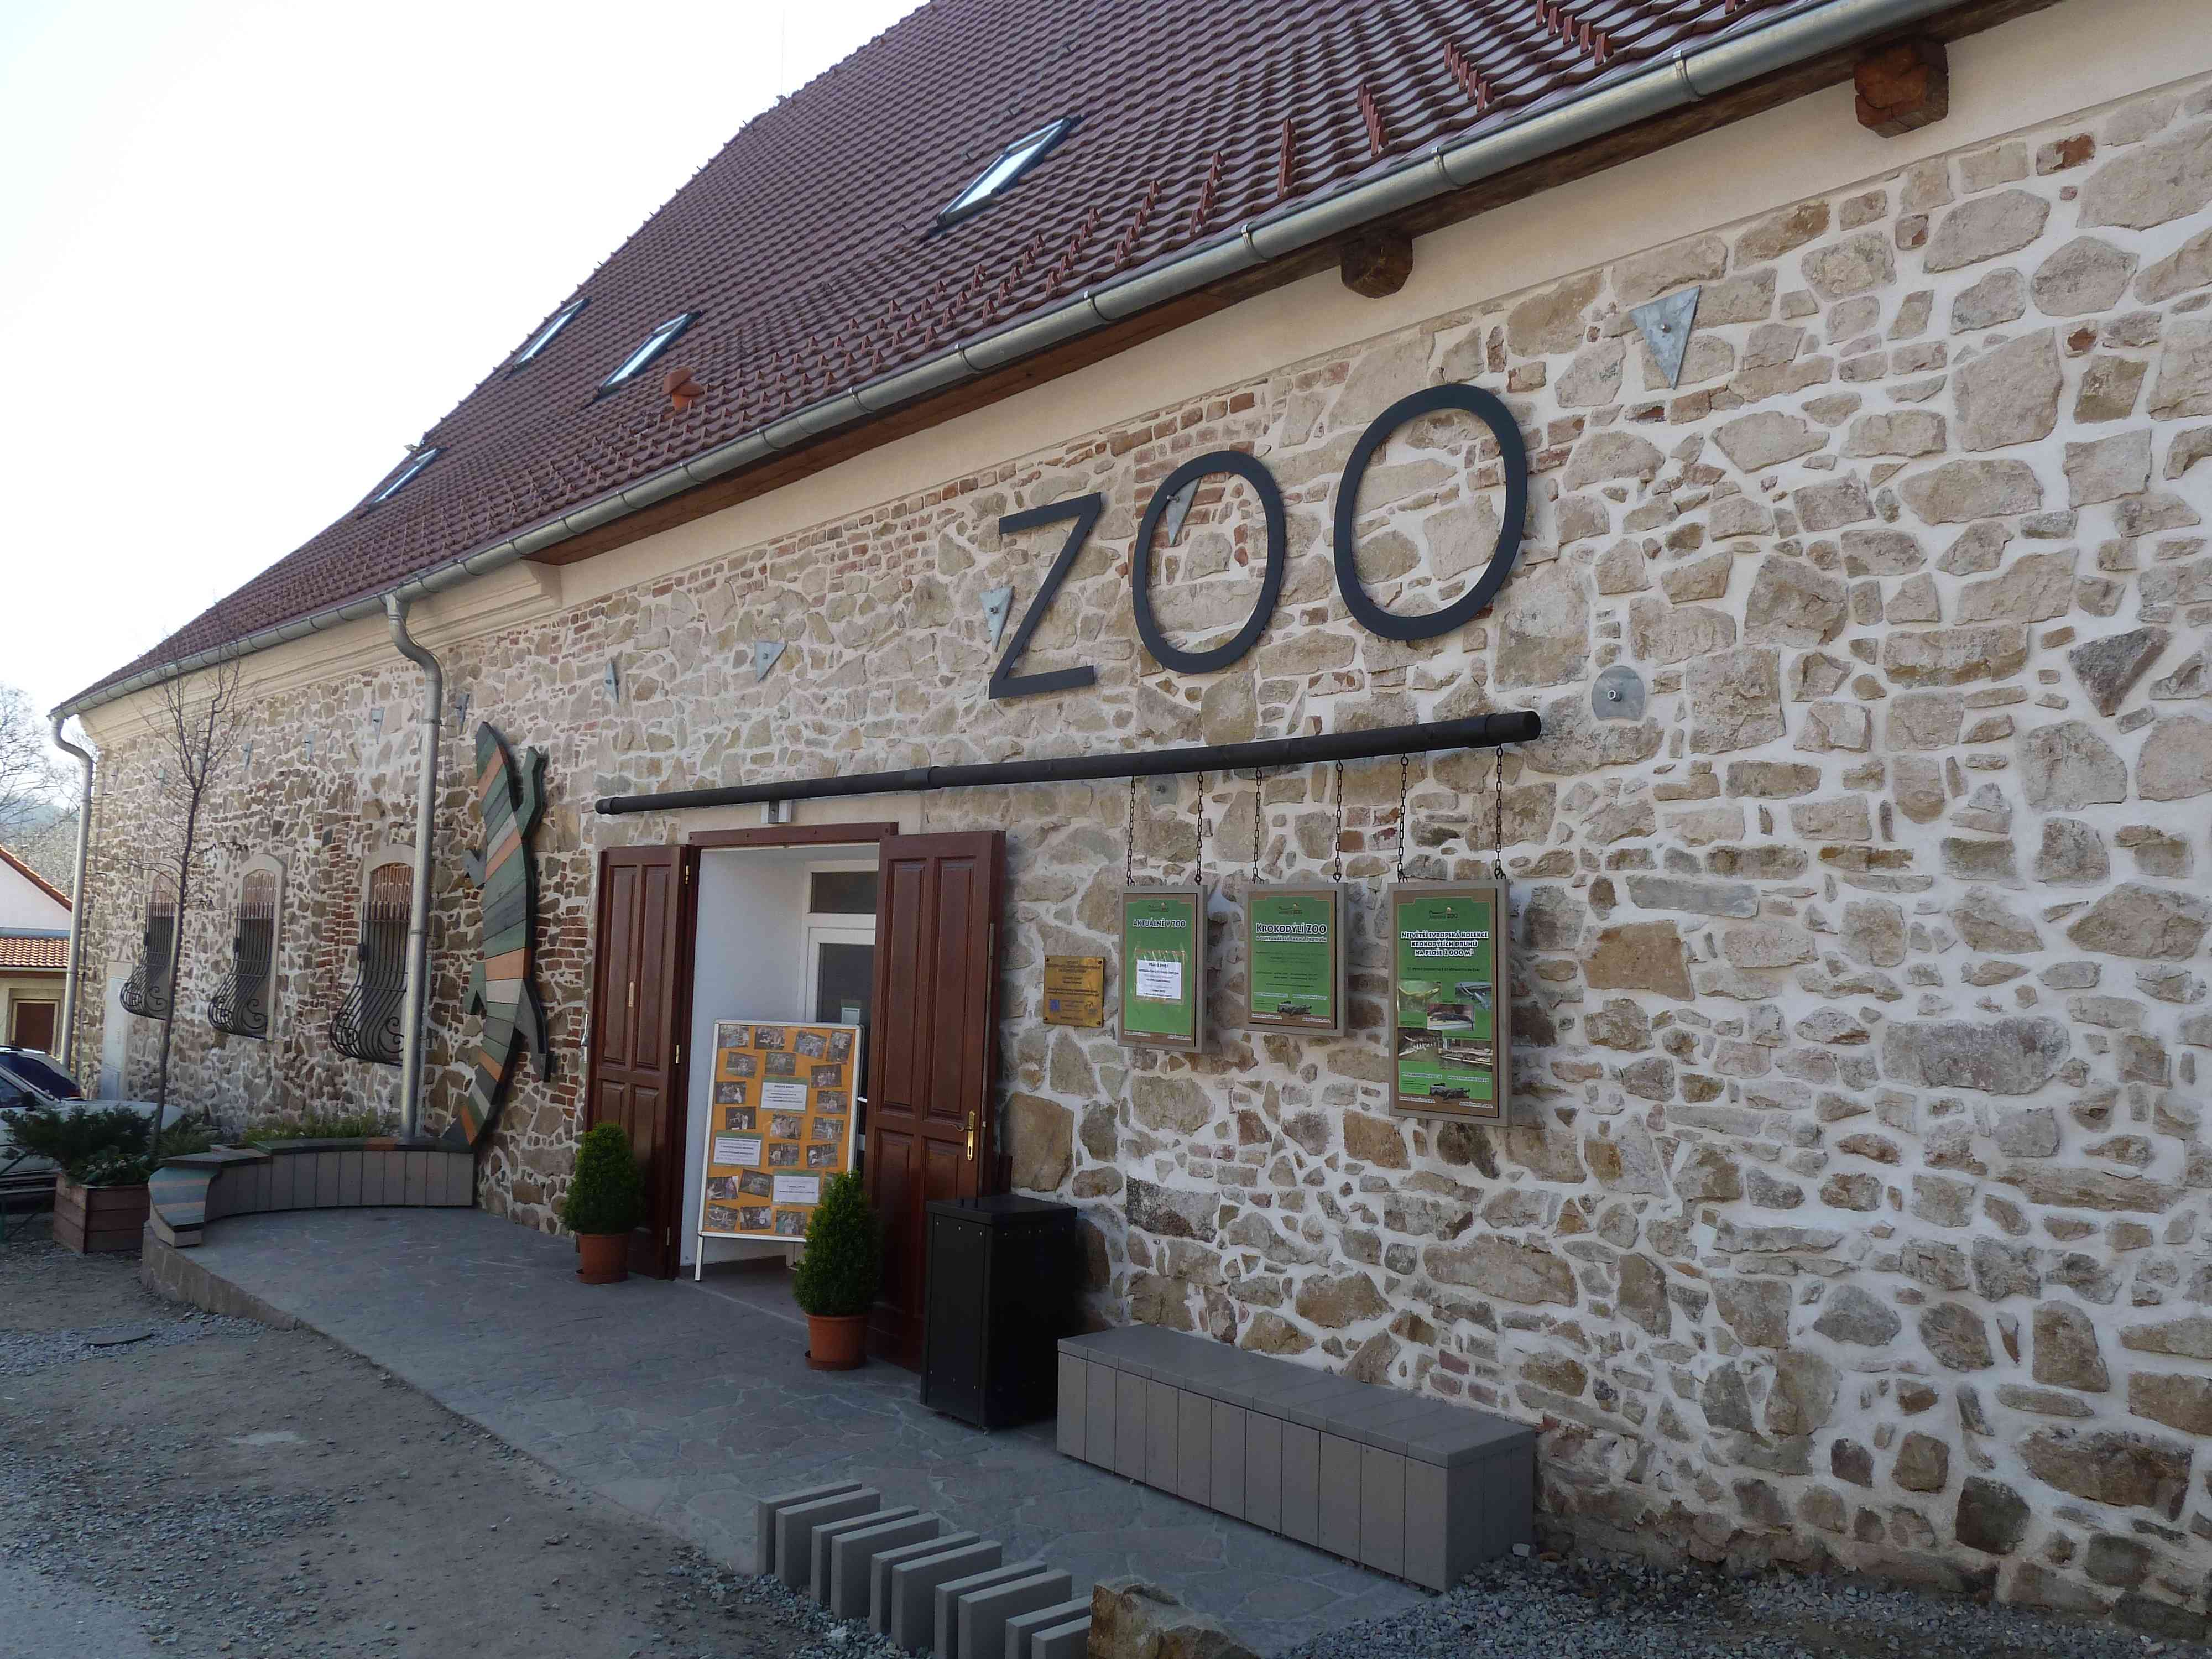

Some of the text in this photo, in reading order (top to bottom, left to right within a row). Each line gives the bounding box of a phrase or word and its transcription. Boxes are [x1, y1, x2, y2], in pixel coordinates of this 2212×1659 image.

[989, 384, 1527, 699] ZOO
[1133, 917, 1186, 928] AKTUÁLNĚ V ZOO
[1306, 924, 1327, 935] ZOO
[1401, 930, 1428, 938] NEJVĚTŠÍ
[1428, 930, 1460, 938] EVROPSKÁ
